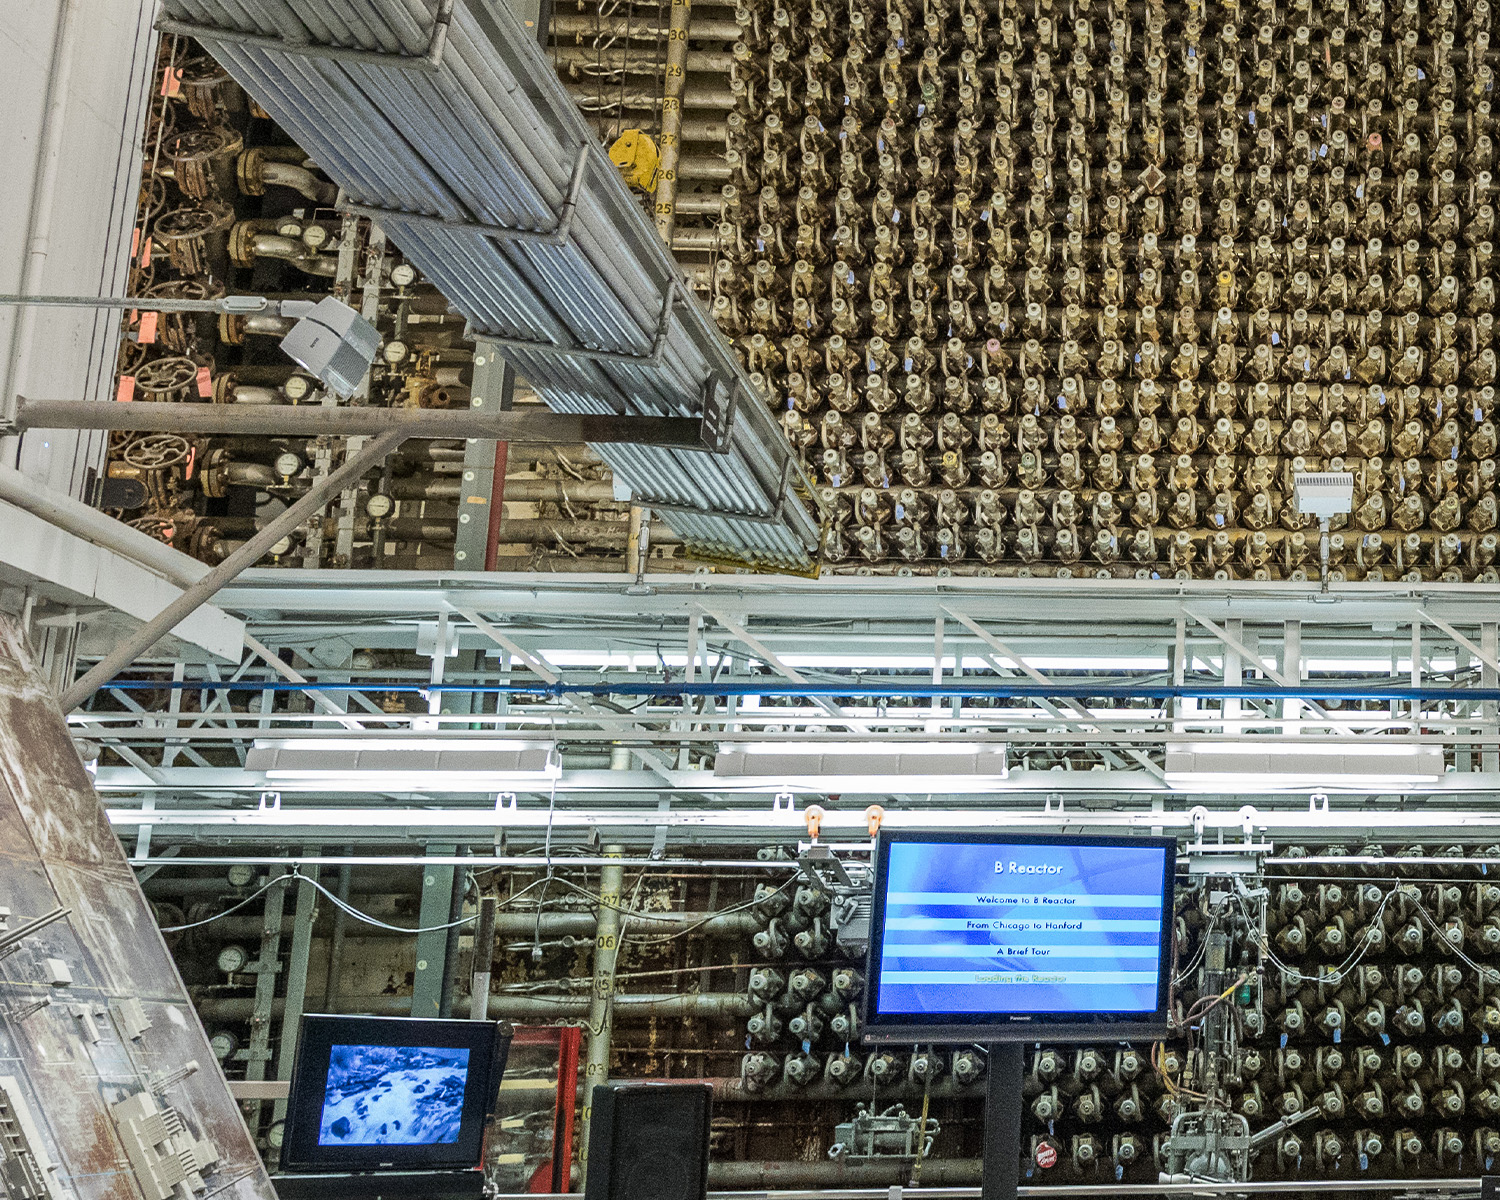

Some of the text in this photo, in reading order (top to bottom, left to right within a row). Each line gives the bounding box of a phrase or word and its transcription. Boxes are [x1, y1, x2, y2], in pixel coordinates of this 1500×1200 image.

[670, 29, 686, 40] 30
[668, 66, 682, 77] 29
[664, 99, 679, 111] 28
[661, 134, 677, 145] 27
[658, 169, 674, 180] 26
[656, 203, 672, 214] 25
[994, 861, 1063, 875] B Reactor
[976, 895, 1076, 905] Welcome to B Reactor
[966, 920, 1083, 931] From Chicago to Hanford
[597, 935, 614, 948] 06
[996, 947, 1050, 956] A Brief Tour
[975, 974, 1012, 983] Loading
